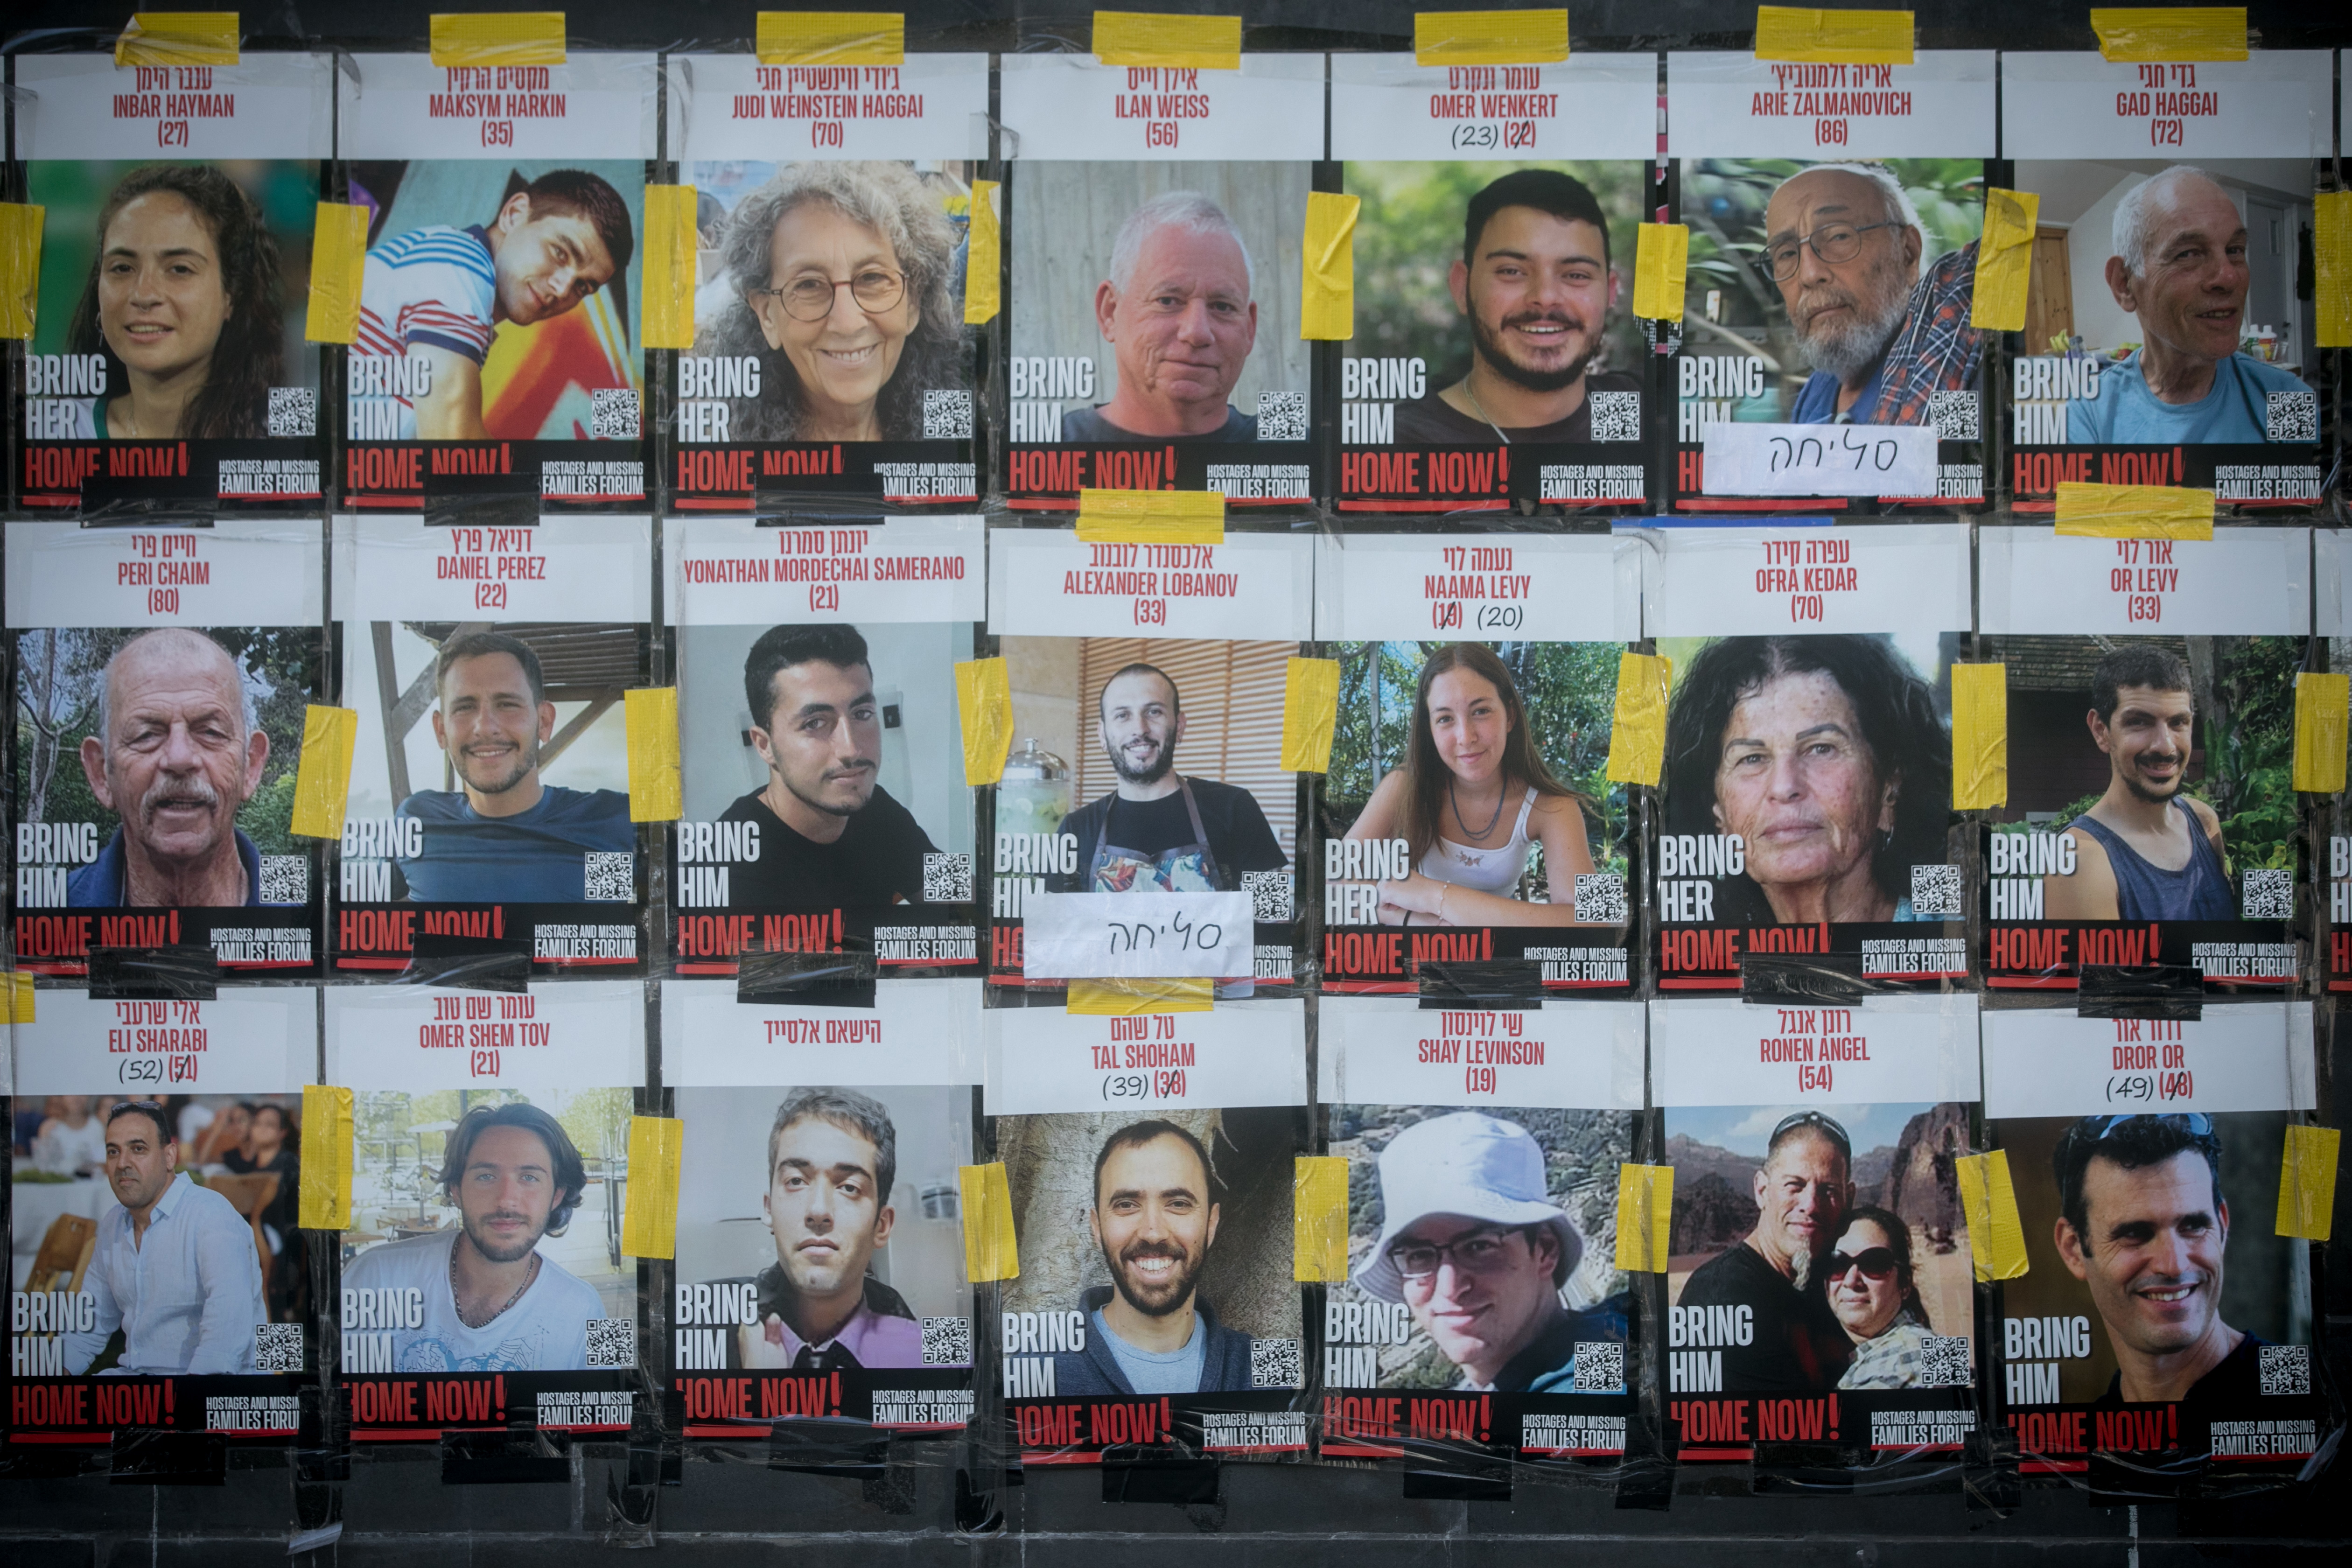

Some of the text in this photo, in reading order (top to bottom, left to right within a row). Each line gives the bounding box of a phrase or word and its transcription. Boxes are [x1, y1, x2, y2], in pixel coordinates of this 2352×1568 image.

[136, 67, 211, 92] ענבר הימן
[446, 67, 549, 92] מקסים הרקין
[756, 68, 781, 91] חגי
[788, 67, 858, 93] ווינשטיין
[1127, 69, 1198, 93] אילן וייס
[1449, 66, 1540, 93] עומר ונקרט
[1853, 64, 1892, 88] אריה
[2138, 64, 2195, 88] גדי חגי
[114, 95, 233, 117] INBAR HAYMAN
[430, 94, 565, 117] MAKSYM HARKIN
[733, 95, 923, 119] JUDI WEINSTEIN HAGGAI
[1116, 95, 1209, 118] ILAN WEISS
[1430, 94, 1558, 118] OMER WENKERT
[1751, 92, 1911, 116] ARIE ZALMANOVICH
[2117, 92, 2217, 116] GAD HAGGAI
[158, 120, 189, 147] (27)
[482, 120, 513, 147] (35)
[812, 121, 843, 148] (70)
[1146, 121, 1178, 148] (56)
[1452, 124, 1498, 150] (23)
[1815, 119, 1848, 146] (86)
[2151, 119, 2183, 146] (72)
[348, 355, 430, 396] BRING
[1342, 357, 1426, 399] BRING
[348, 400, 399, 440] HIM
[1342, 403, 1394, 444] HIM
[1770, 428, 1897, 472] סליחה
[347, 448, 423, 489] HOME
[542, 461, 644, 475] HOSTAGES AND MISSING
[1342, 446, 1512, 494] HOME NOW!
[1540, 465, 1644, 479] HOSTAGES AND MISSING
[542, 476, 644, 495] FAMILIES FORUM
[1540, 479, 1644, 499] FAMILIES FORUM
[132, 535, 196, 558] חיים פרי
[451, 527, 532, 554] דניאל פרץ
[779, 530, 868, 556] יונתן סמרנו
[1763, 540, 1849, 567] עפרה קידר
[2116, 538, 2172, 564] אור לוי
[437, 556, 545, 580] DANIEL PEREZ
[1090, 542, 1213, 569] אלכסנדר לובנוב
[1443, 546, 1512, 571] נעמה לוי
[119, 562, 209, 585] PERI CHAIM
[684, 556, 964, 583] YONATHAN MORDECHAI SAMERANO
[1756, 567, 1857, 593] OFRA KEDAR
[2111, 568, 2178, 592] OR LEVY
[475, 582, 506, 609] (22)
[1064, 571, 1238, 597] ALEXANDER LOBANOV
[1425, 575, 1531, 599] NAAMA LEVY
[148, 588, 179, 615] (80)
[809, 584, 839, 612] (21)
[1791, 595, 1823, 623] (70)
[2128, 595, 2161, 623] (33)
[1134, 598, 1166, 626] (33)
[1477, 605, 1523, 630] (20)
[678, 821, 760, 862] BRING
[1325, 839, 1409, 880] BRING
[678, 867, 729, 907] HIM
[1325, 884, 1378, 925] HER
[678, 908, 846, 956] HOME NOW!
[875, 926, 976, 940] HOSTAGES AND MISSING
[1108, 911, 1222, 955] סליחה
[875, 940, 976, 960] FAMILIES FORUM
[116, 1000, 200, 1025] אלי שרעבי
[434, 996, 534, 1021] עומר שם טוב
[420, 1023, 550, 1048] OMER SHEM TOV
[763, 1019, 881, 1044] הישאם אלסייד
[1111, 1015, 1174, 1041] טל שהם
[1441, 1011, 1522, 1038] שי לוינסון
[1778, 1009, 1851, 1036] רונן אנגל
[109, 1029, 207, 1052] ELI SHARABI
[1419, 1039, 1544, 1065] SHAY LEVINSON
[1760, 1037, 1870, 1063] RONEN ANGEL
[471, 1050, 500, 1078] (21)
[1092, 1043, 1195, 1069] TAL SHOHAM
[2113, 1045, 2184, 1070] DROR OR
[119, 1058, 163, 1084] (52)
[1466, 1066, 1496, 1094] (19)
[1799, 1064, 1832, 1092] (54)
[1103, 1074, 1148, 1101] (39)
[2106, 1075, 2154, 1103] (49)
[1325, 1302, 1409, 1344] BRING
[2004, 1316, 2090, 1359] BRING
[1324, 1347, 1376, 1388] HIM
[2006, 1363, 2060, 1405] HIM
[1323, 1394, 1493, 1442] HOME NOW!
[1523, 1414, 1626, 1430] HOSTAGES AND MISSING
[1523, 1428, 1626, 1450] FAMILIES FORUM
